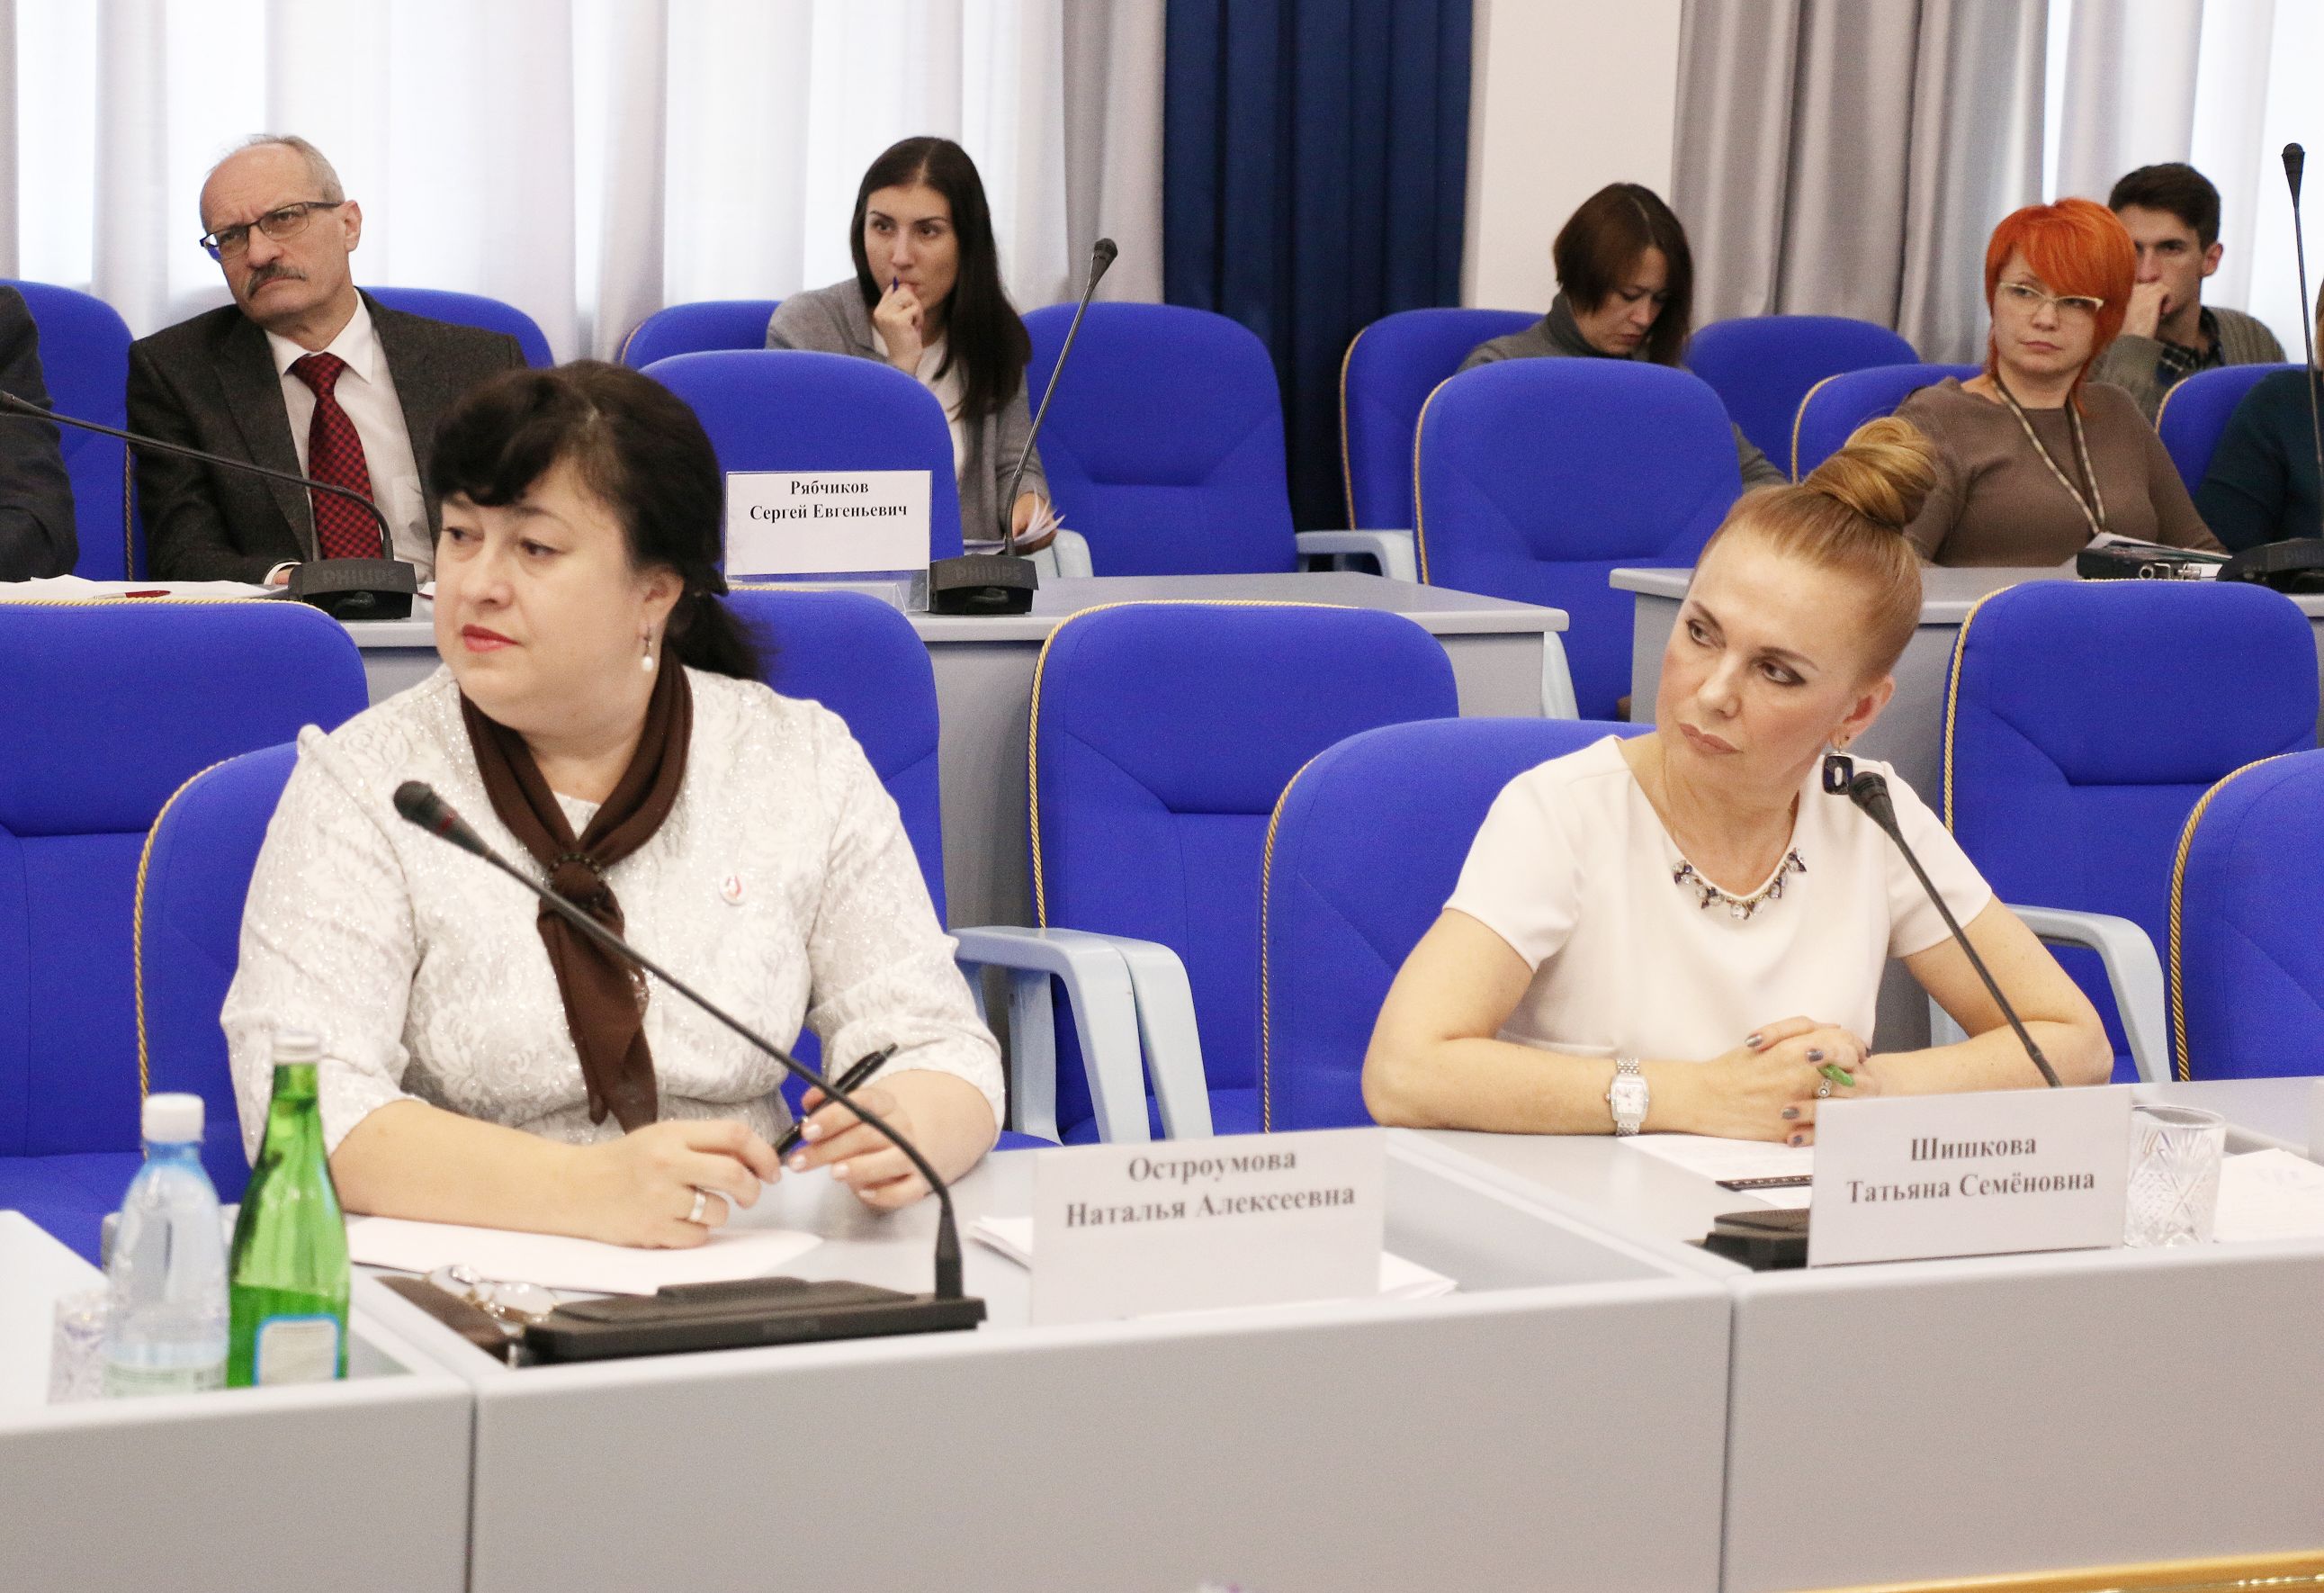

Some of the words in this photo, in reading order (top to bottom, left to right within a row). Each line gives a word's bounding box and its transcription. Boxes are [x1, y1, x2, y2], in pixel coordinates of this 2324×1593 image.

[791, 480, 870, 495] Рябчиков
[749, 504, 807, 524] Сергей
[813, 503, 908, 519] Евгеньевич
[323, 568, 397, 584] PHILIPS
[1910, 1137, 2037, 1162] Шишкова
[1127, 1151, 1297, 1185] Остроумова
[1846, 1179, 1951, 1204] Татьяна
[1959, 1172, 2096, 1197] Семёновна
[1066, 1201, 1187, 1228] Наталья
[1198, 1186, 1356, 1218] Алексеевна
